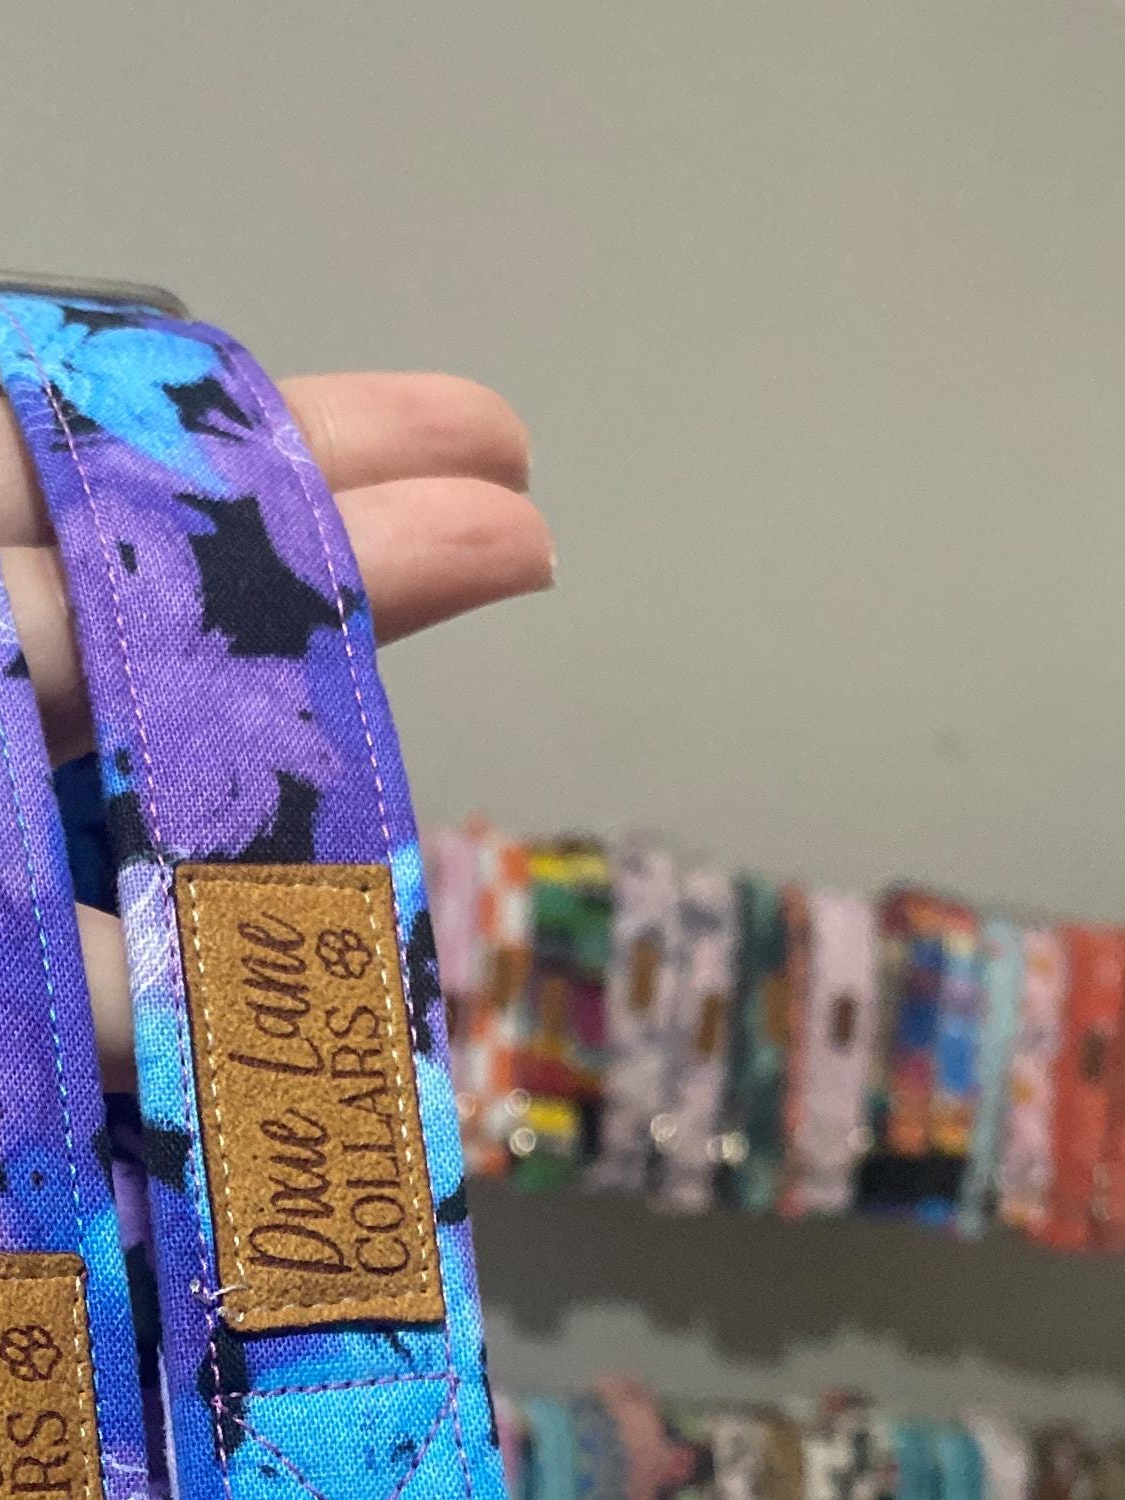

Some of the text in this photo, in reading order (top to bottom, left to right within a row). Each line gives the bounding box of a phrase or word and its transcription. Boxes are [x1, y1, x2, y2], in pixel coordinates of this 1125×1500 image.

[228, 911, 353, 1275] Dixie Lane
[326, 1005, 410, 1275] COLLARS
